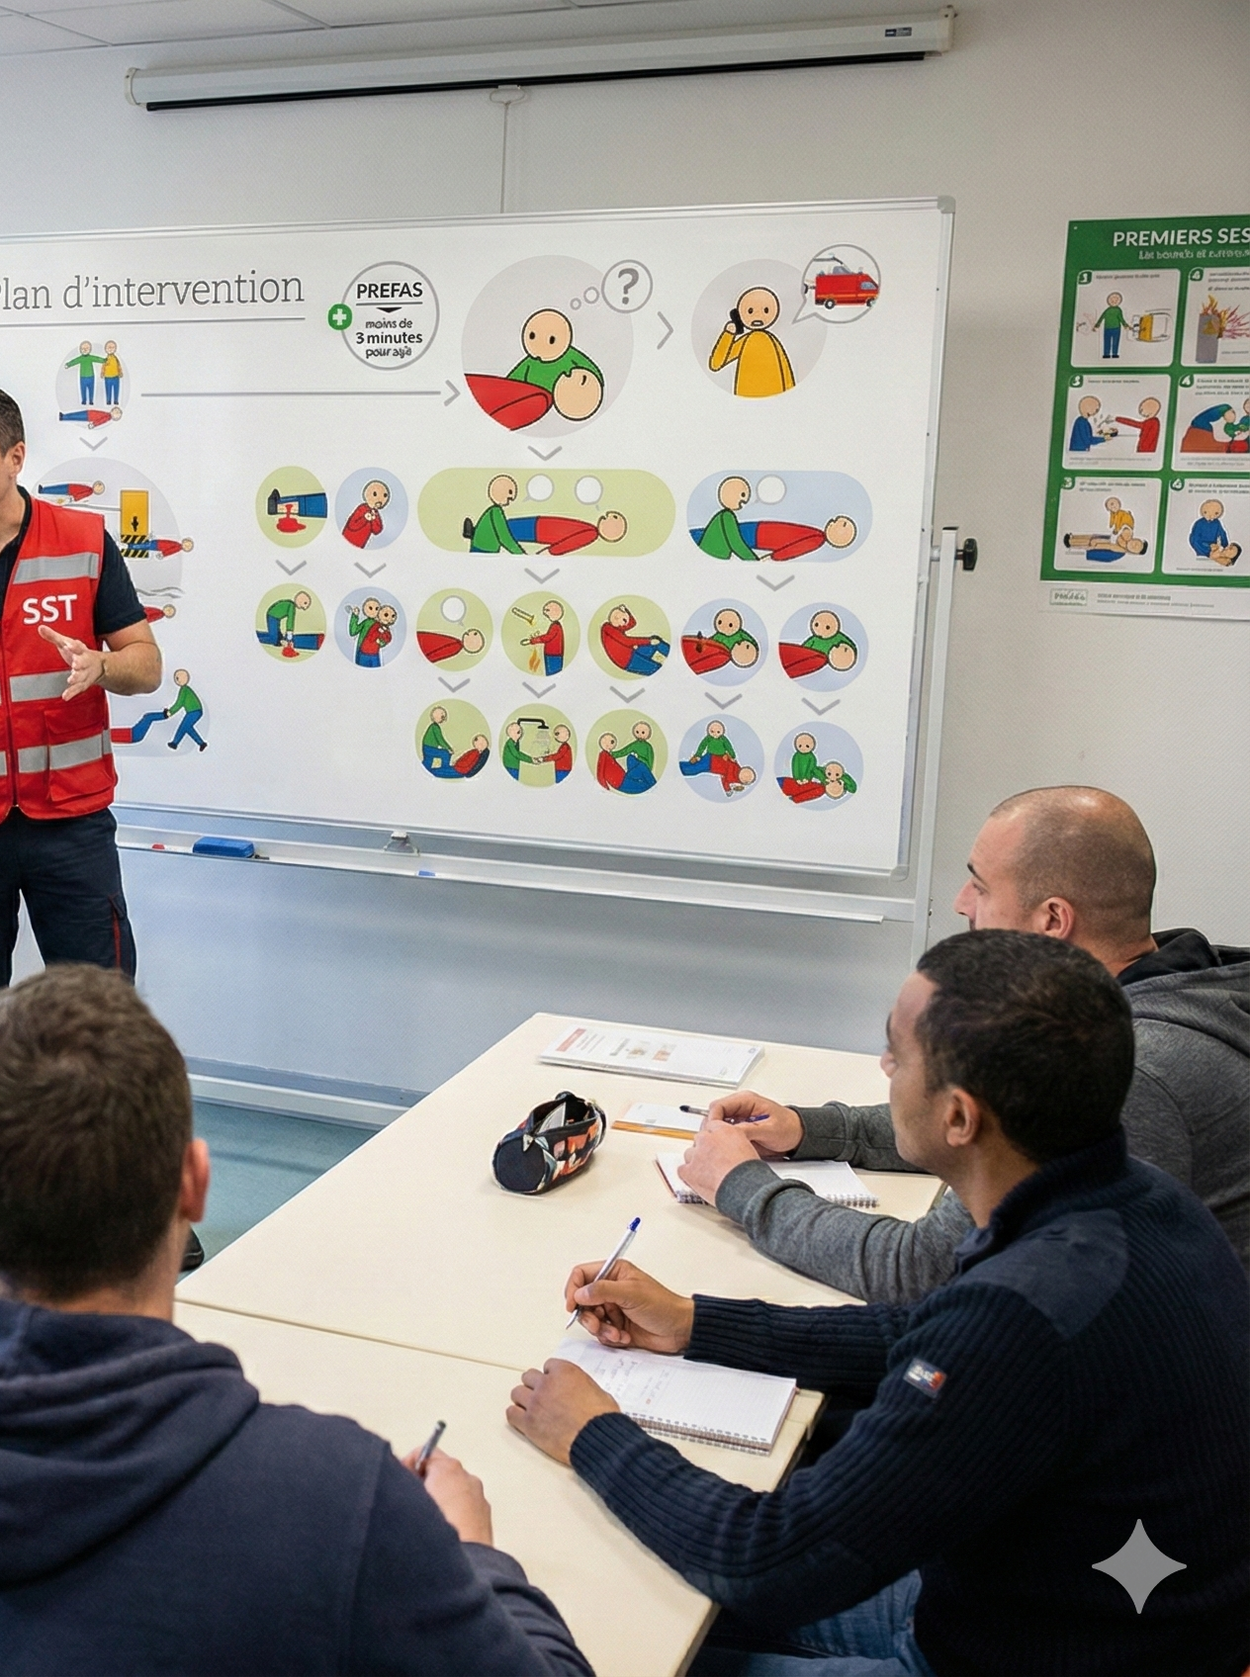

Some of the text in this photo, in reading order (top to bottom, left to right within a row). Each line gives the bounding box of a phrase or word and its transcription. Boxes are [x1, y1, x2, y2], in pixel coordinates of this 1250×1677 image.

[1113, 228, 1213, 247] PREMIERS
[63, 269, 305, 308] d’intervention
[356, 281, 423, 299] PREFAS
[365, 317, 413, 329] moins de
[355, 331, 423, 345] 3 minutes
[365, 347, 392, 359] pour
[22, 593, 78, 625] SST
